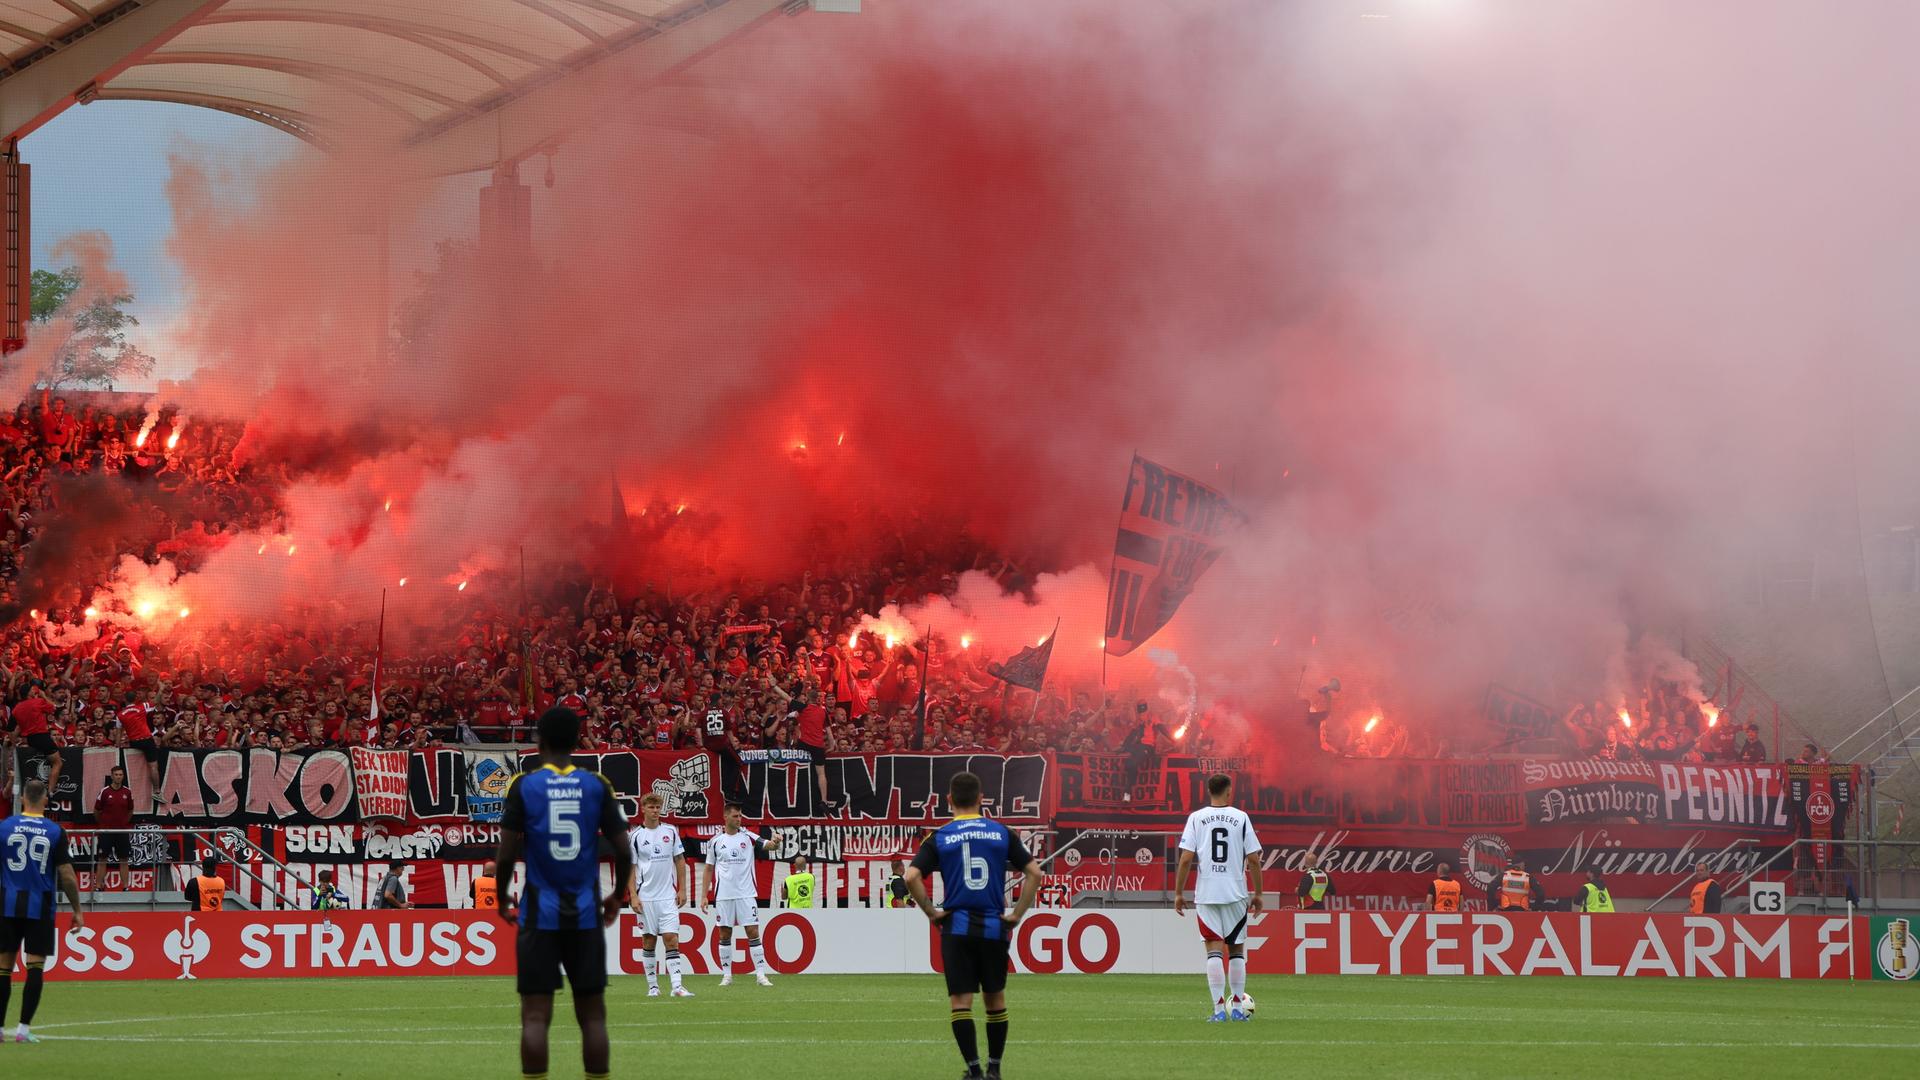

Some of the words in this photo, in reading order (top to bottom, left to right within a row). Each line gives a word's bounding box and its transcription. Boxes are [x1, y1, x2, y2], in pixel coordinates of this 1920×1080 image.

[706, 714, 723, 731] 25
[352, 748, 408, 774] SEKTION
[357, 774, 408, 796] STADION
[547, 788, 582, 799] KRAHN
[359, 796, 406, 817] VERBOT
[685, 800, 704, 812] 1994
[1540, 784, 1659, 822] Nürnberg
[1810, 804, 1830, 816] FCN
[14, 825, 47, 835] SCHMIDT
[286, 824, 355, 854] SGN
[550, 801, 580, 860] 5
[945, 831, 1002, 844] SONTHEIMER
[7, 833, 51, 875] 39
[1211, 827, 1229, 863] 6
[962, 842, 989, 890] 6
[1212, 865, 1227, 873] FLICK
[1753, 891, 1782, 912] C3
[239, 922, 497, 969] STRAUSS
[619, 912, 817, 975] ERGO
[1295, 913, 1790, 979] FLYERALARM
